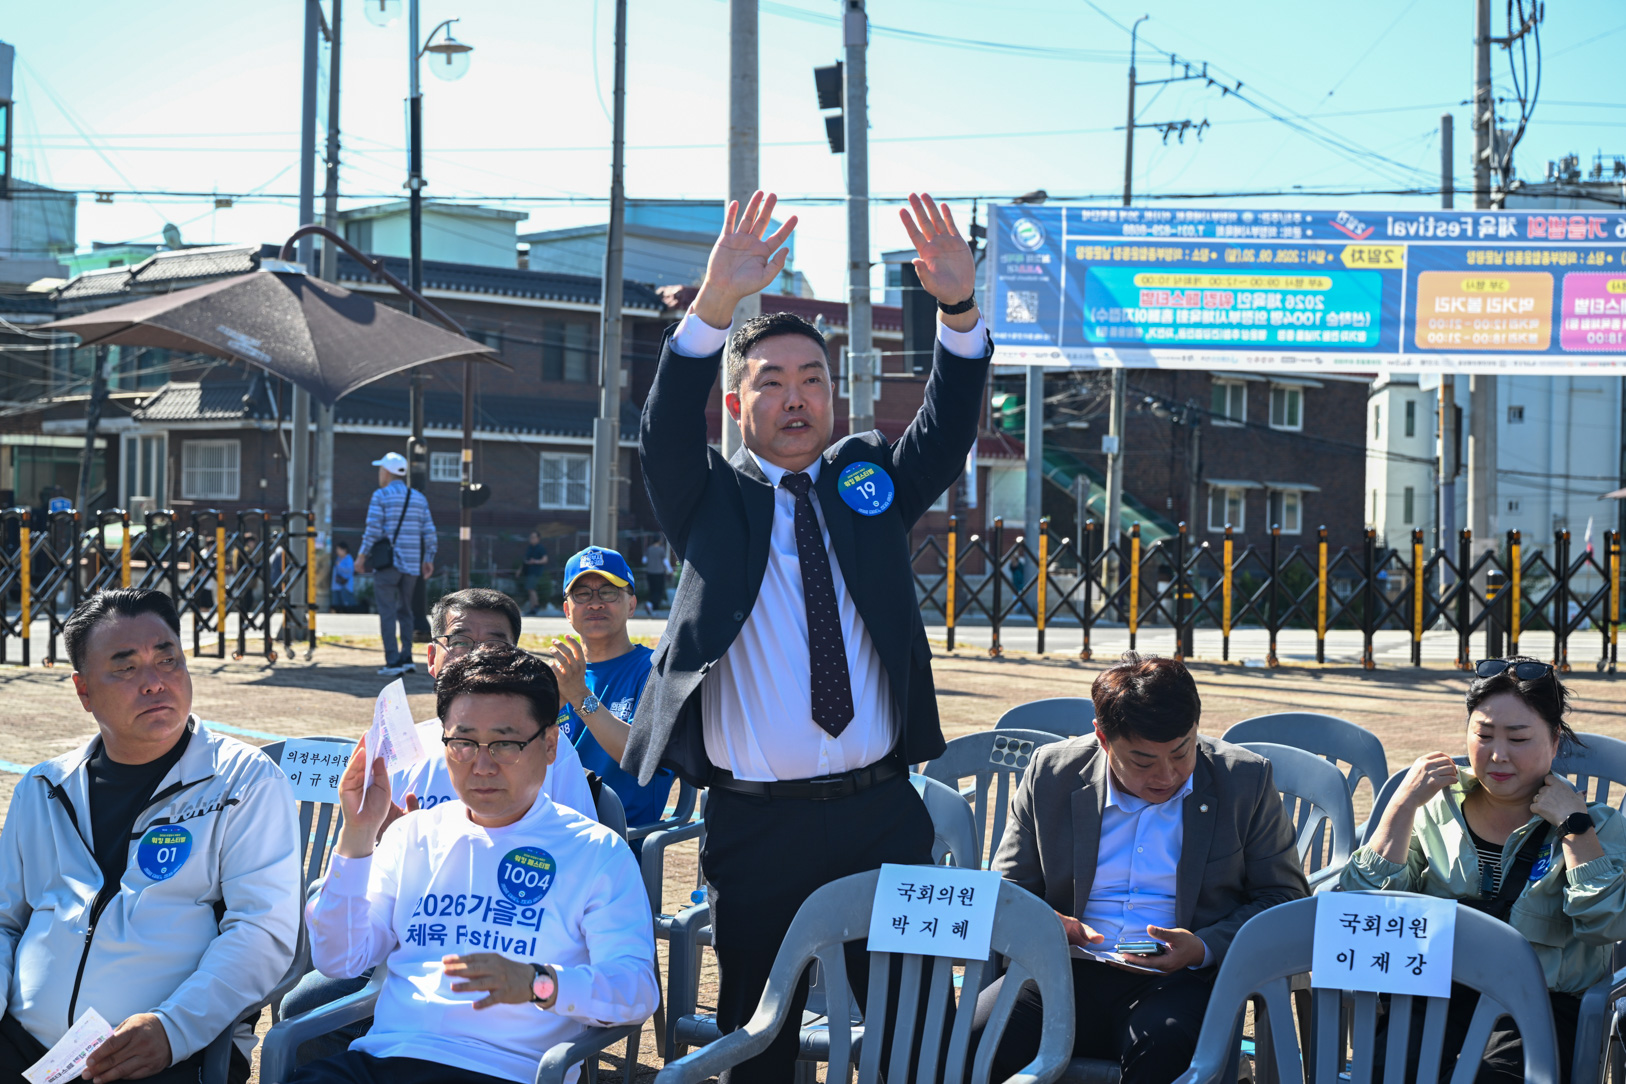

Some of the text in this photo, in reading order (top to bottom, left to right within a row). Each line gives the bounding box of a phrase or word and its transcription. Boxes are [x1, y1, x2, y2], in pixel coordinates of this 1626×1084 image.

[844, 478, 856, 487] 워킹
[854, 468, 875, 482] 페스티벌
[856, 481, 876, 500] 19
[157, 847, 177, 863] 01
[515, 854, 527, 864] 워킹
[527, 859, 550, 870] 페스티벌
[504, 863, 550, 890] 1004
[897, 882, 975, 906] 국회의원
[412, 894, 545, 932] 2026가을의
[405, 923, 447, 946] 체육
[1339, 913, 1428, 939] 국회의원
